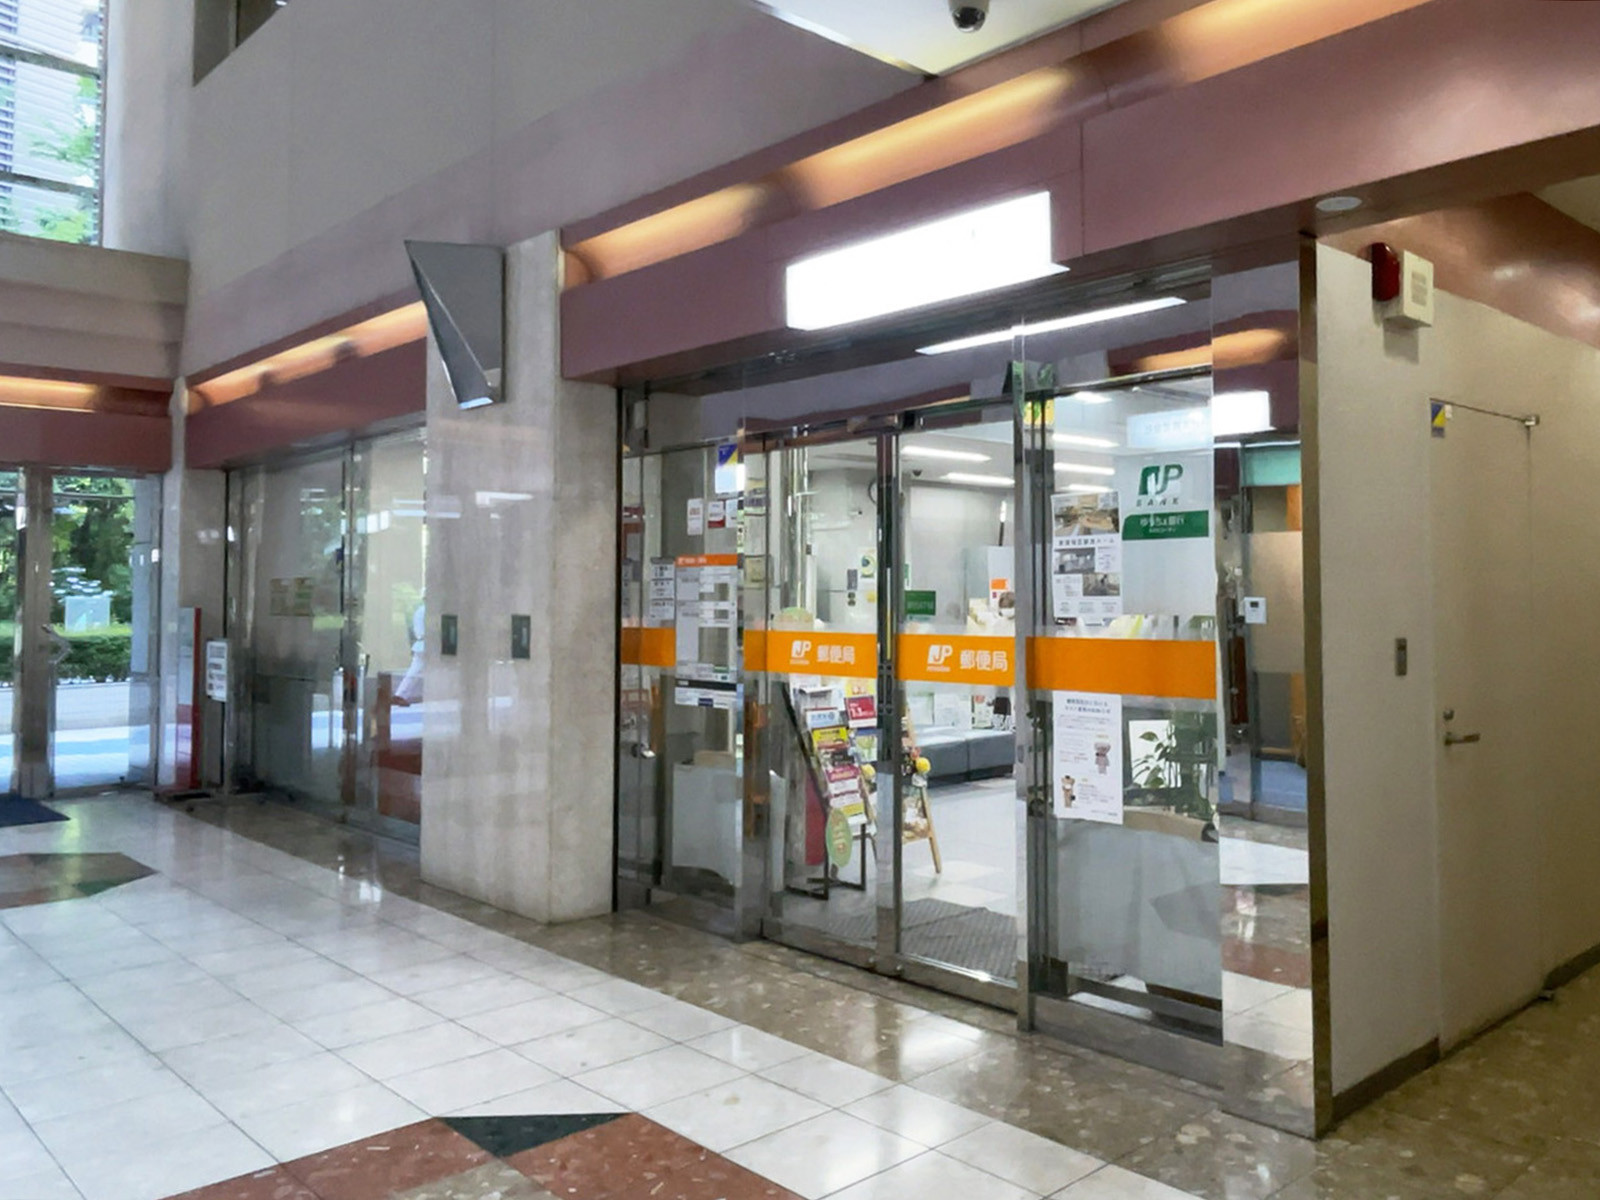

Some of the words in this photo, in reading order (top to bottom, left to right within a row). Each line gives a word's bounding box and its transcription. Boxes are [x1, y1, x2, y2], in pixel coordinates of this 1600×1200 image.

[817, 645, 856, 665] 郵便局
[960, 649, 1008, 671] 郵便局
